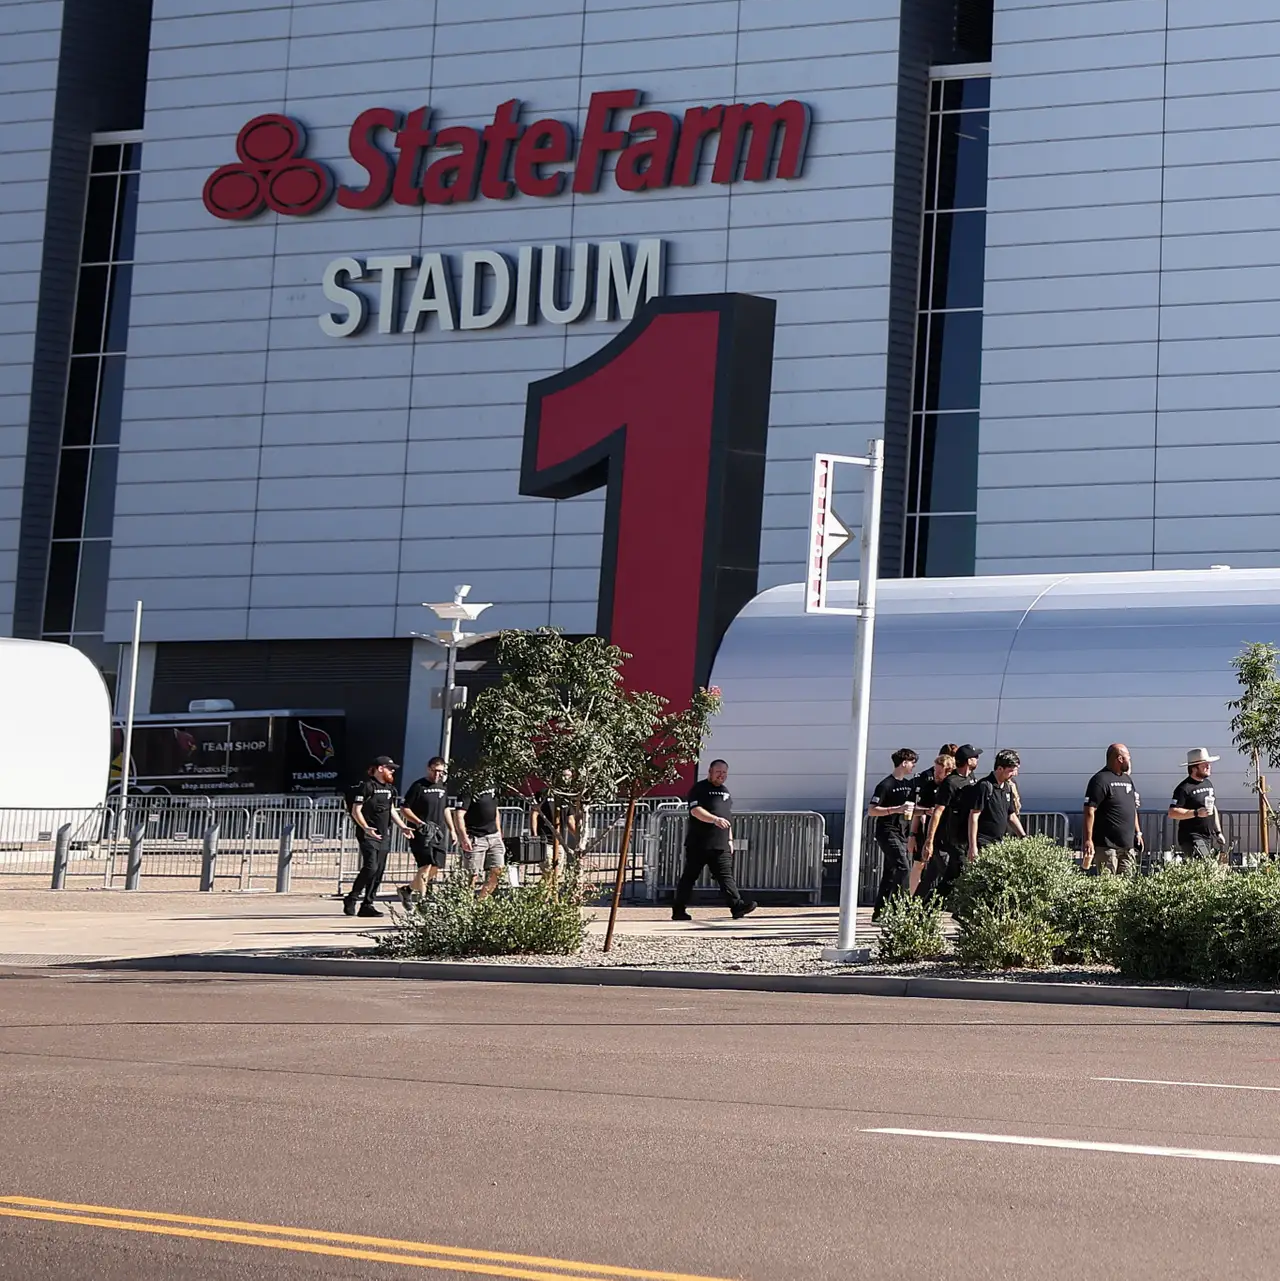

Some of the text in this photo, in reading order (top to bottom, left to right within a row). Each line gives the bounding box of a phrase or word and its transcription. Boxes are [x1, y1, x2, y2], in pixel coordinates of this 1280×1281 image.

[318, 237, 669, 338] STADIUM
[519, 293, 776, 780] 1
[202, 740, 267, 752] TEAM SHOP
[292, 771, 339, 780] TEAM SHOP
